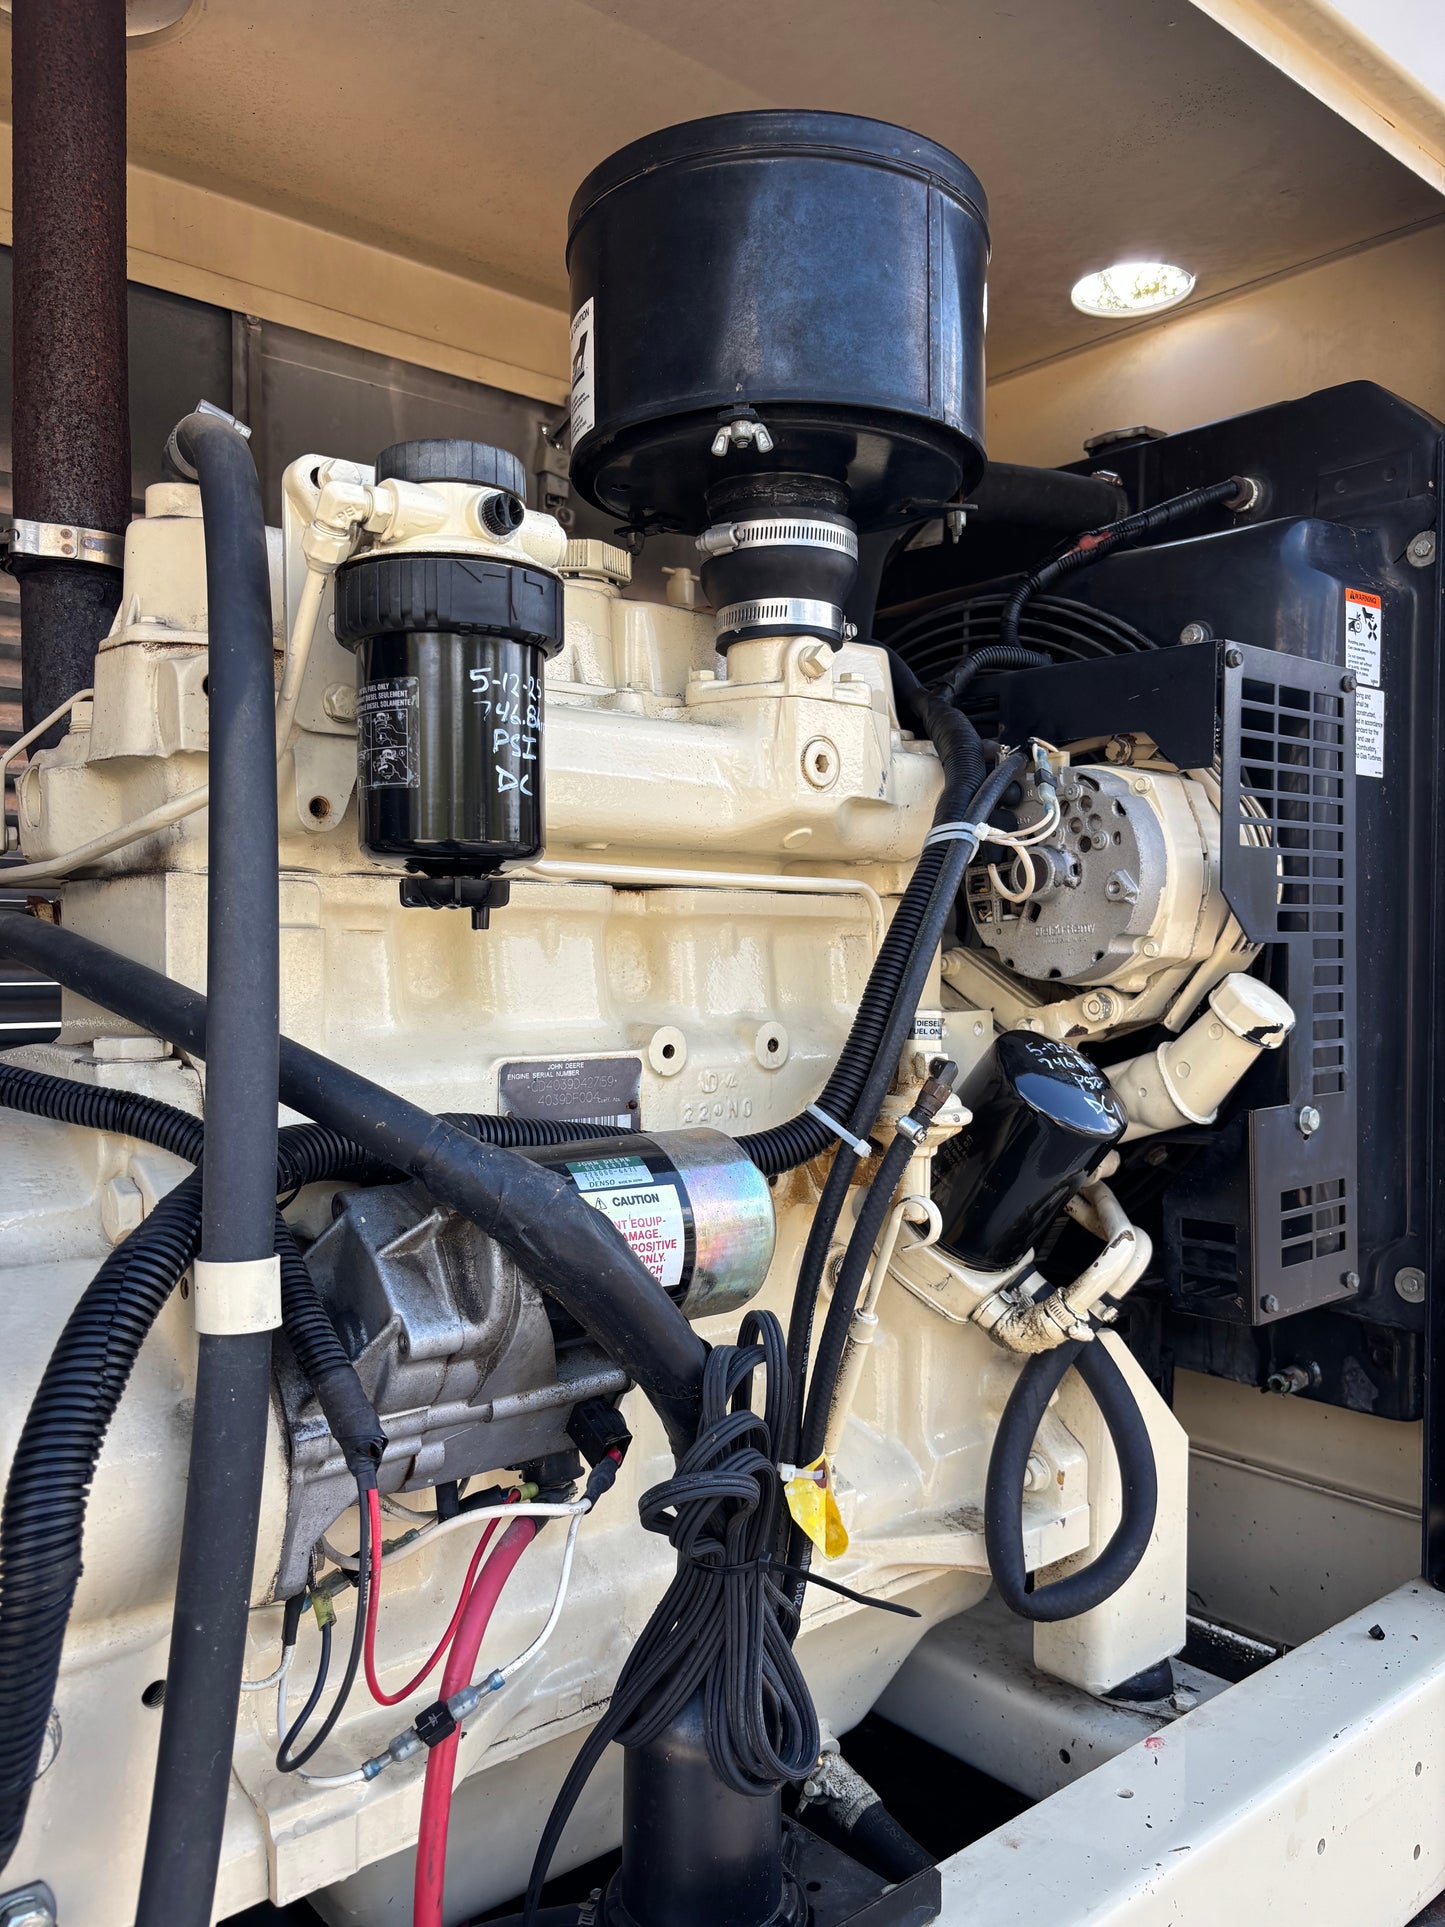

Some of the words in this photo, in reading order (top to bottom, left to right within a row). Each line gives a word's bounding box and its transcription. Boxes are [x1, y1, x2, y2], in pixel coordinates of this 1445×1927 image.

[1354, 593, 1377, 605] WARNING
[377, 682, 390, 691] ONLY
[493, 728, 537, 760] PSI
[507, 1073, 530, 1081] ENGINE
[532, 1071, 554, 1079] SERIAL
[589, 1180, 616, 1188] DENSO
[612, 1193, 660, 1207] CAUTION
[630, 1216, 666, 1229] EQUIP-
[623, 1228, 662, 1242] AMAGE.
[632, 1238, 678, 1252] POSITIVE
[640, 1252, 666, 1264] ONLY.
